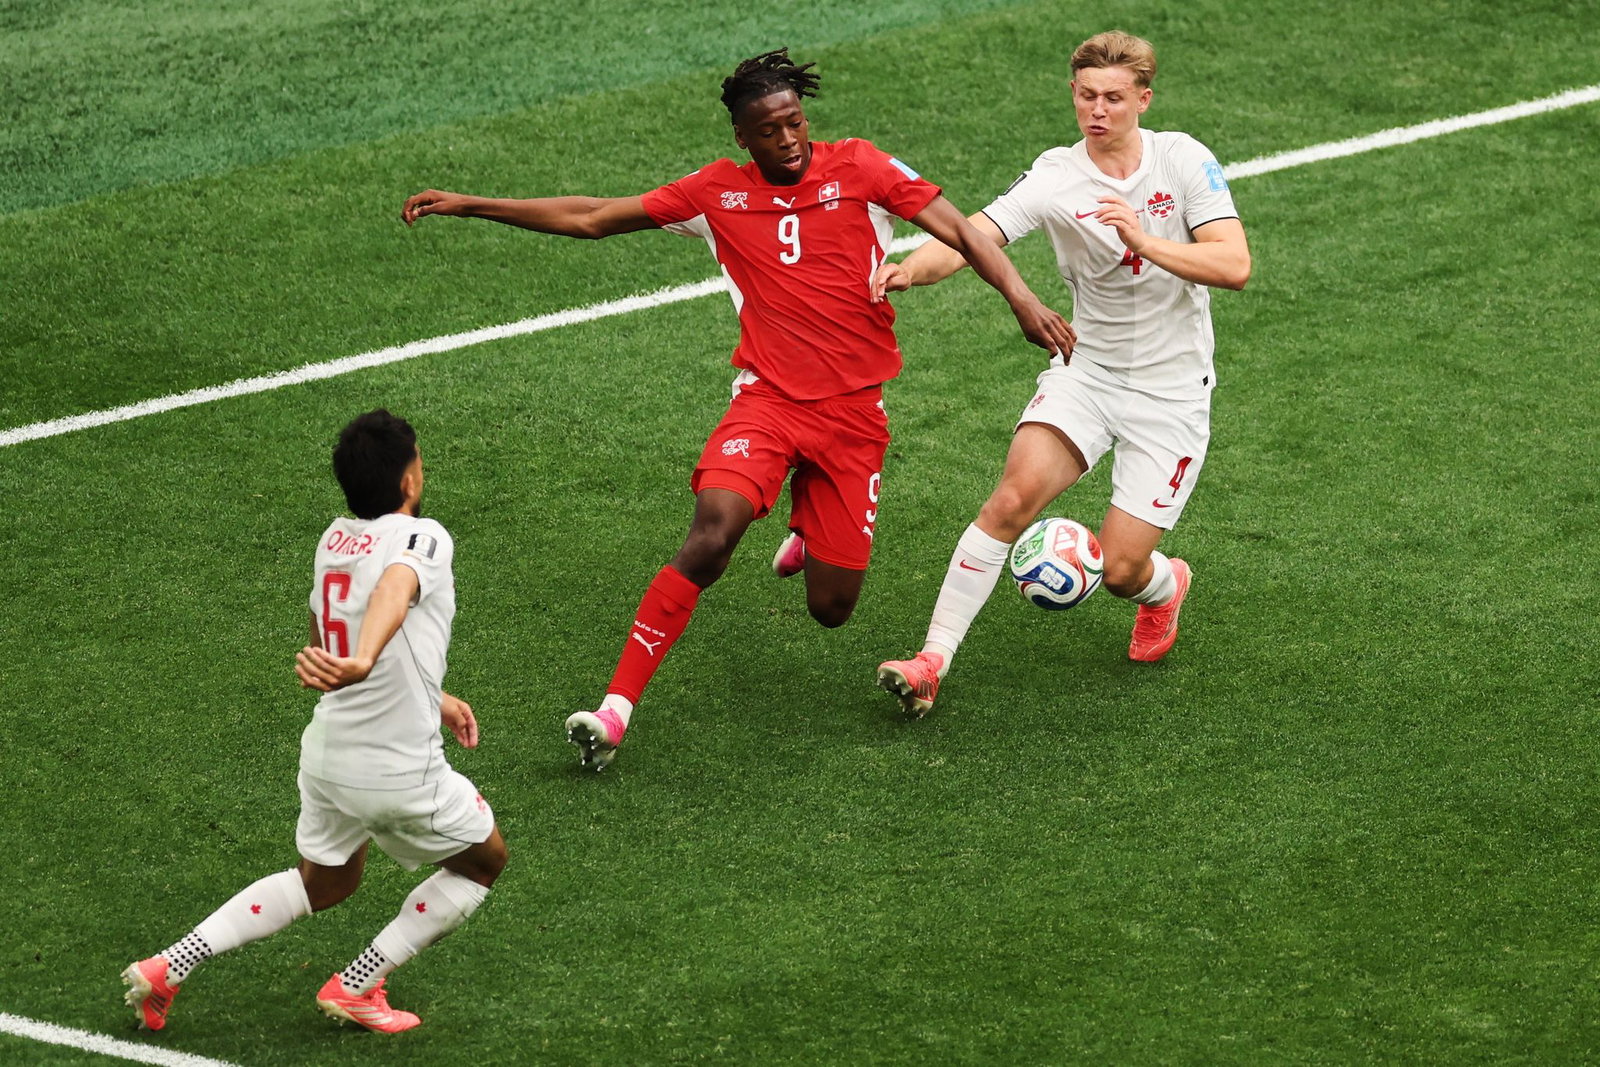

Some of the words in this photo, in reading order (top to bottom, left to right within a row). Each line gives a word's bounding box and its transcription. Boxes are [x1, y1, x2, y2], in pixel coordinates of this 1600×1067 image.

[1147, 199, 1175, 211] CANADA
[777, 213, 802, 265] 9
[1120, 248, 1143, 275] 4
[1168, 455, 1193, 498] 4
[323, 570, 352, 658] 6
